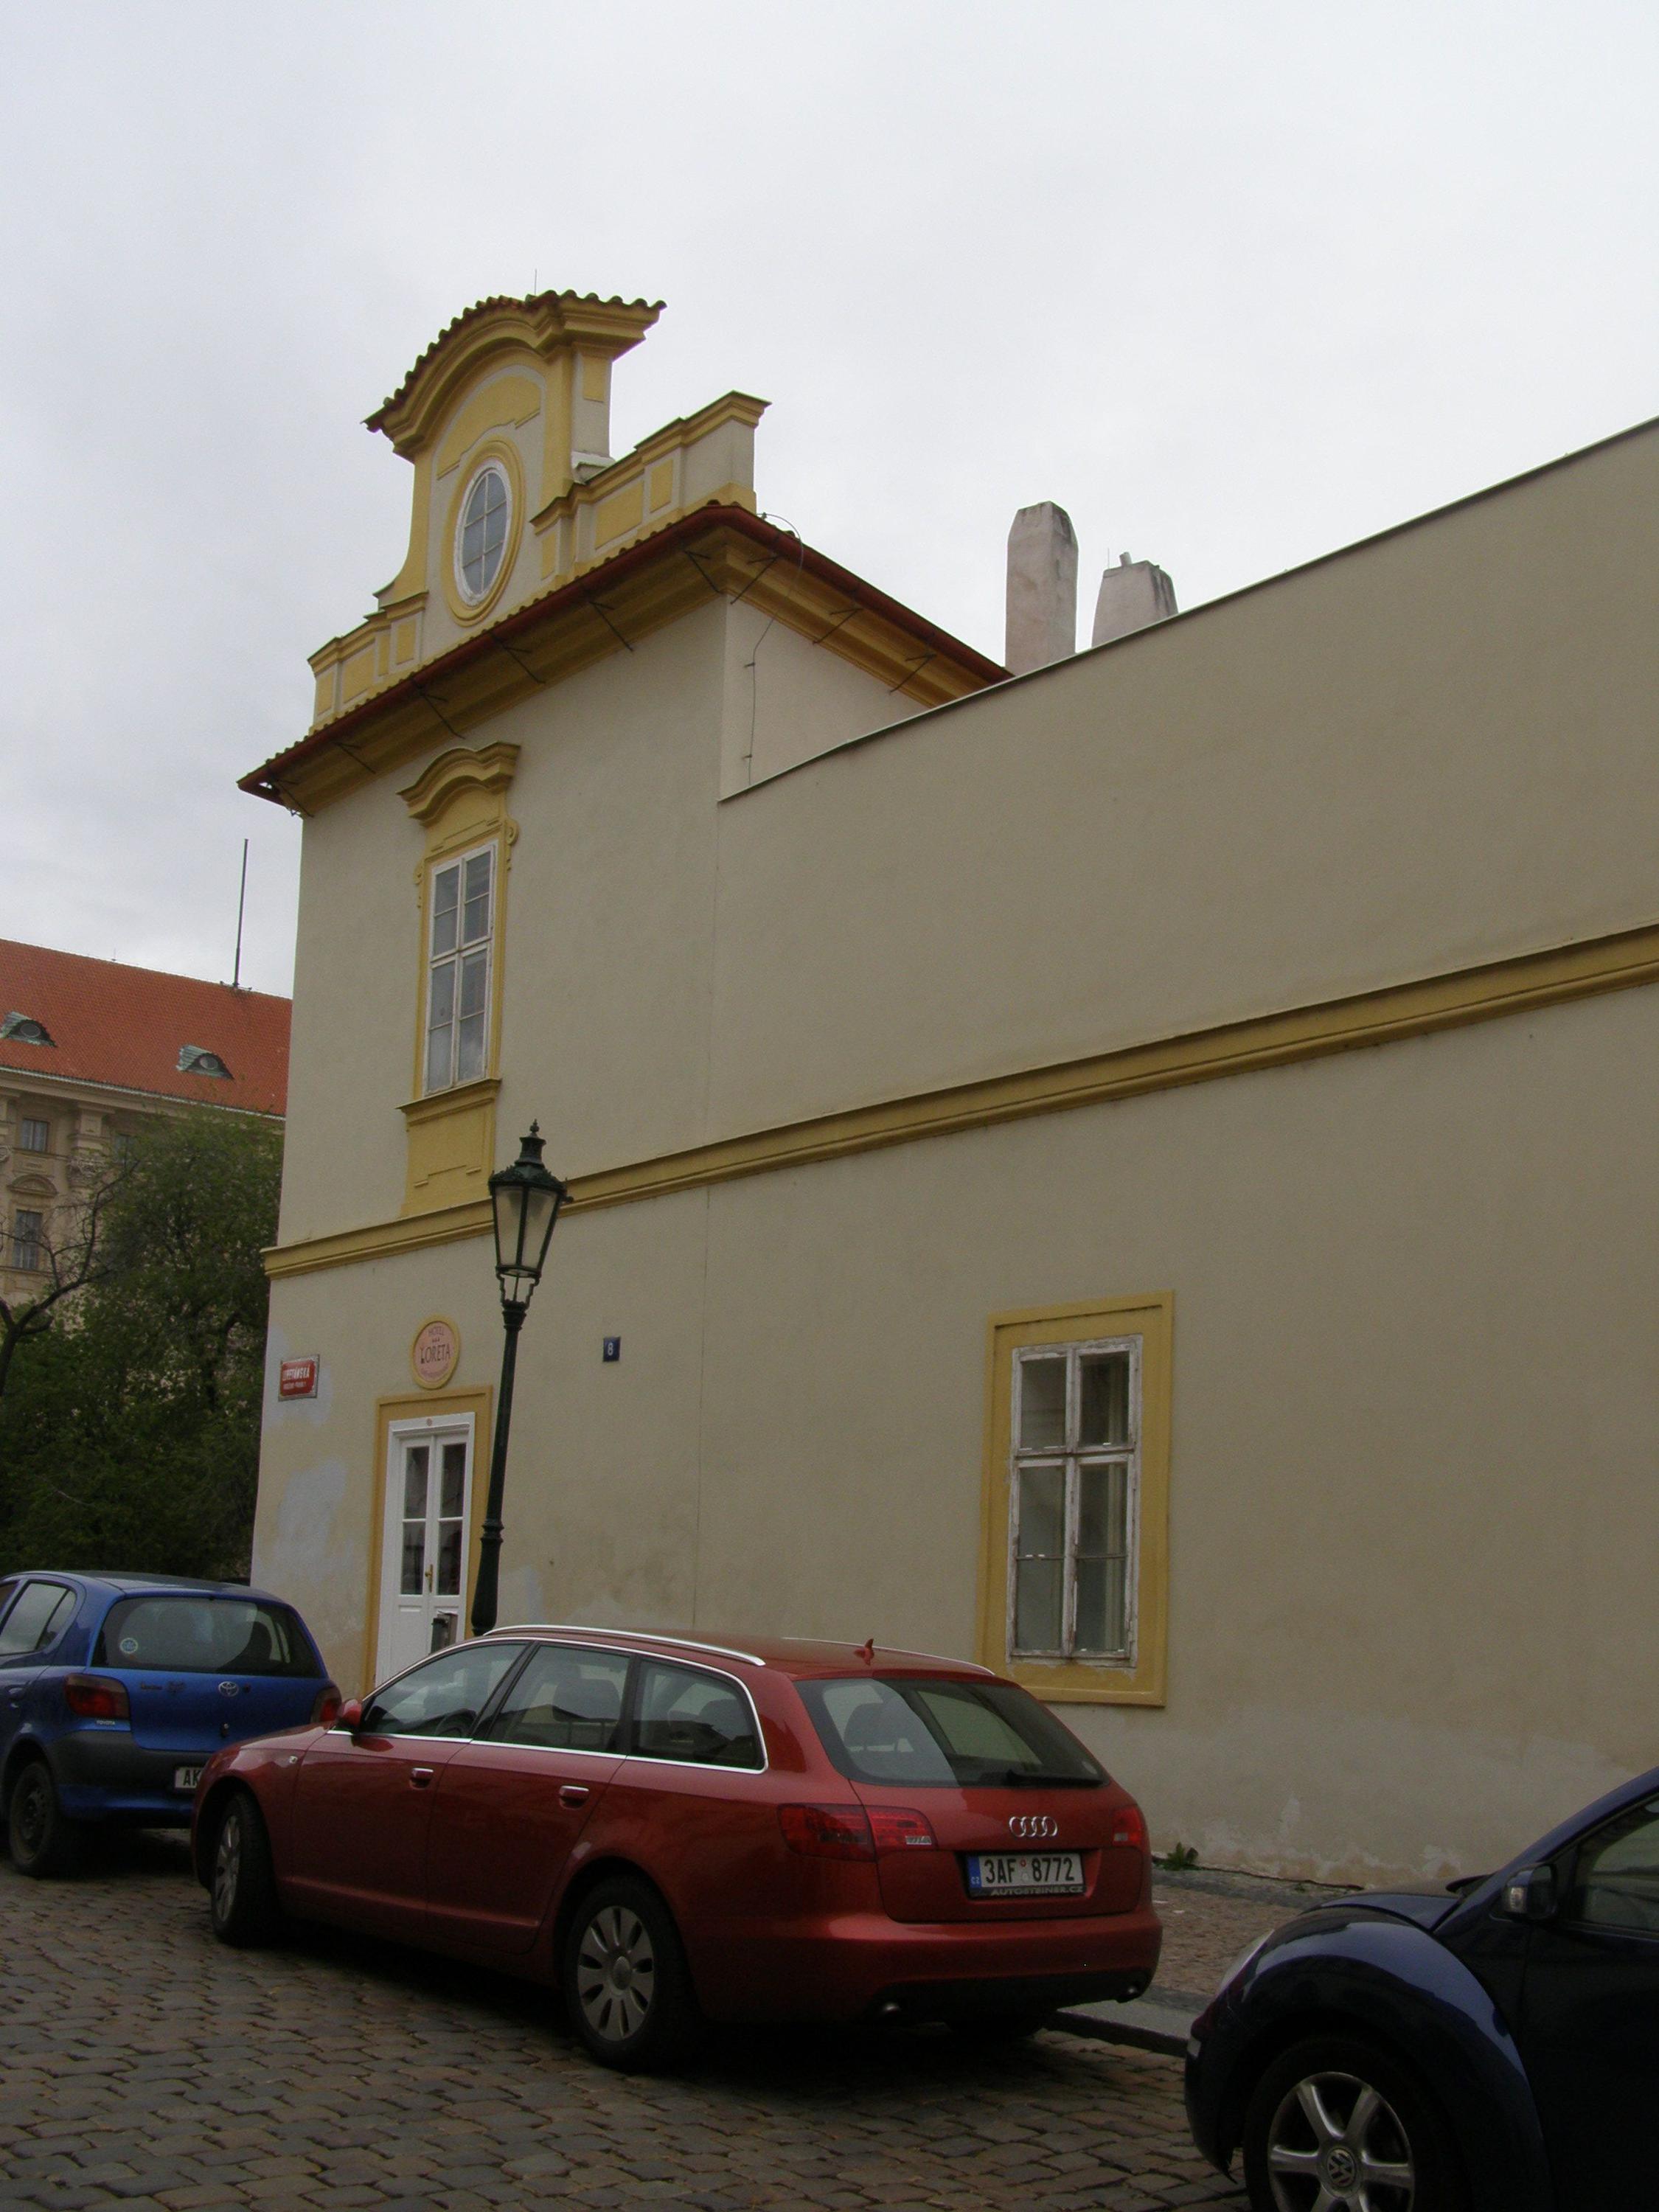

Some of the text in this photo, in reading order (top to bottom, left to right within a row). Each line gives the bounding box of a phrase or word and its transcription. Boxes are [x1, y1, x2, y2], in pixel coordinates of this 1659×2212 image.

[420, 1343, 451, 1364] LORETA
[608, 1342, 613, 1356] 8
[984, 1857, 1074, 1883] 3AF 8772
